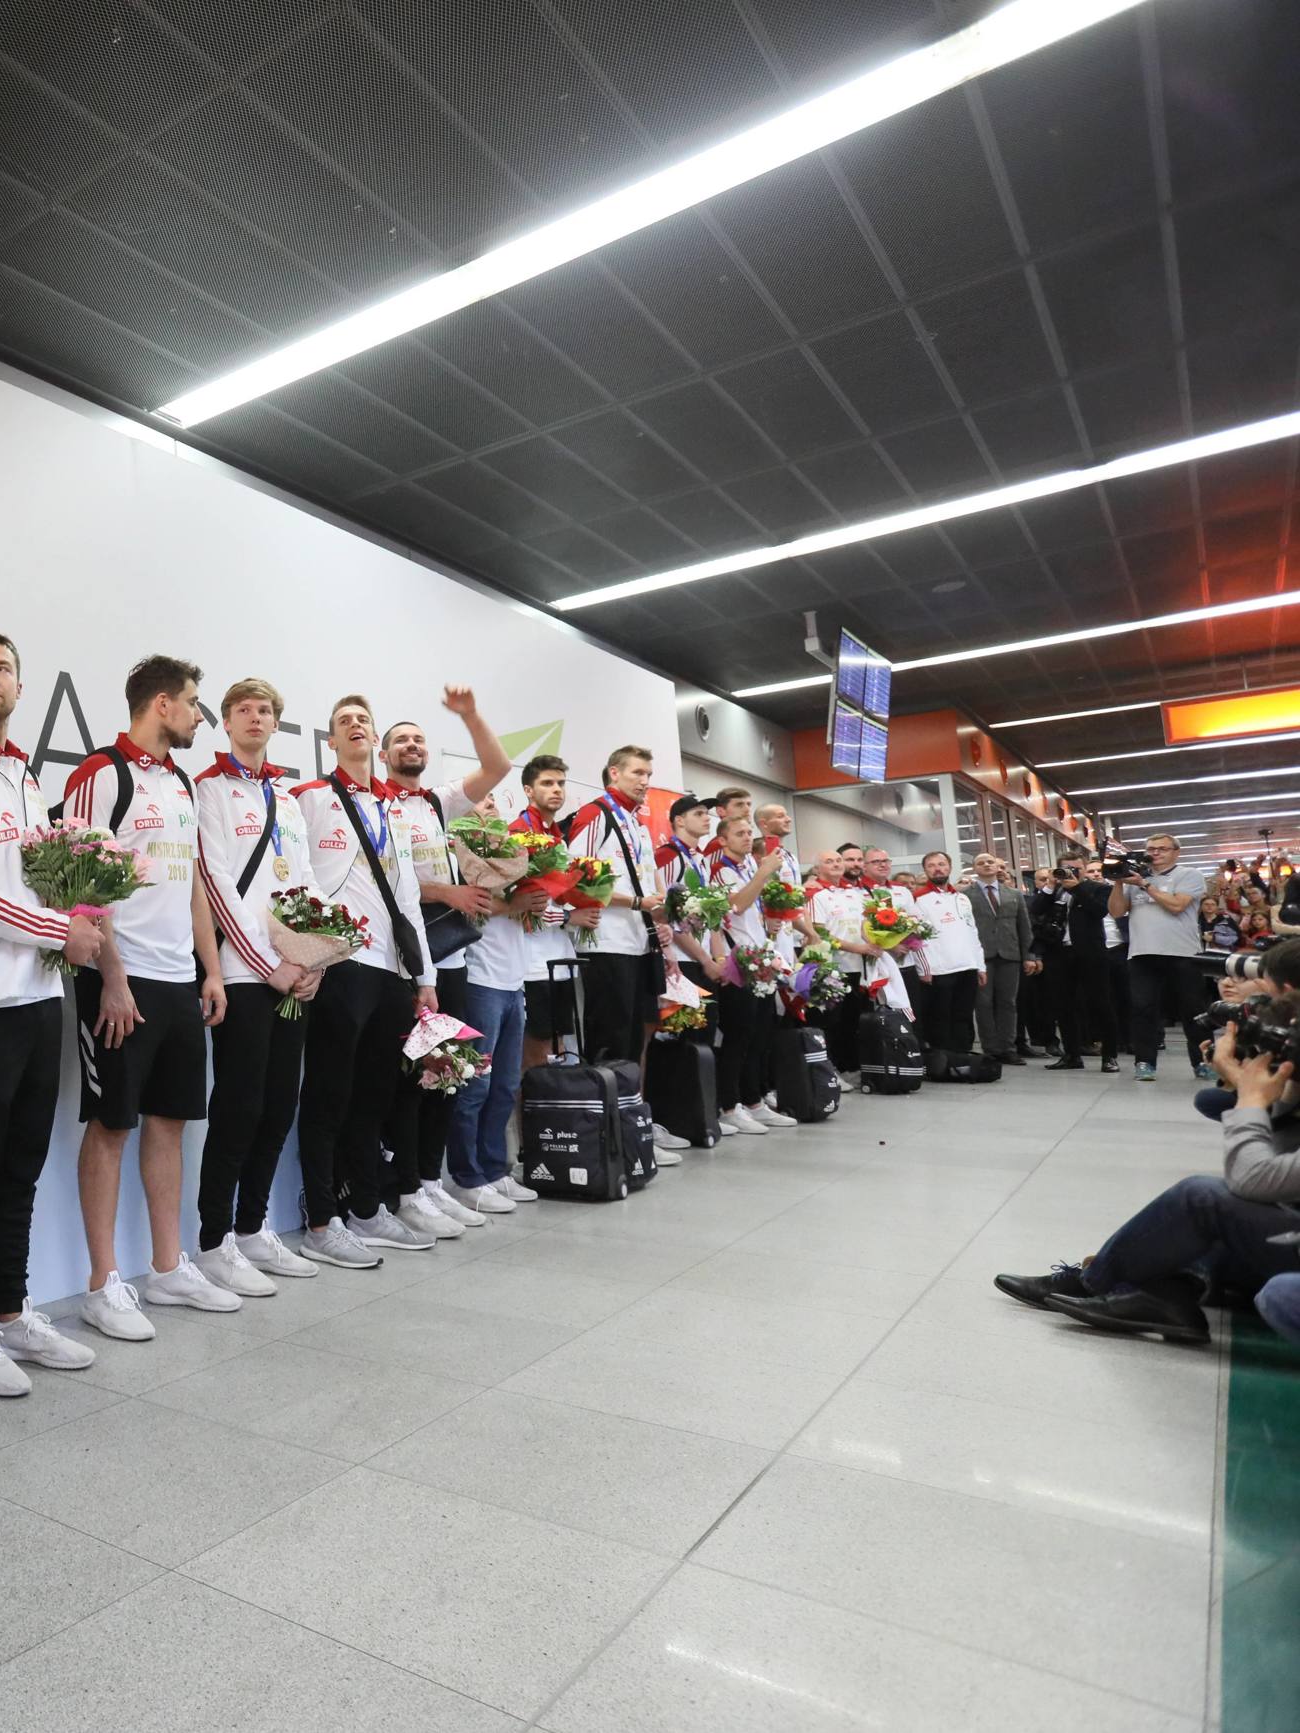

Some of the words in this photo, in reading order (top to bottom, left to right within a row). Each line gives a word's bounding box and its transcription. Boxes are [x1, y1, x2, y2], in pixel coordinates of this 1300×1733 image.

[136, 819, 163, 829] ORLEN
[237, 826, 261, 835] ORLEN
[320, 841, 346, 850] ORLEN
[168, 864, 188, 880] 2018
